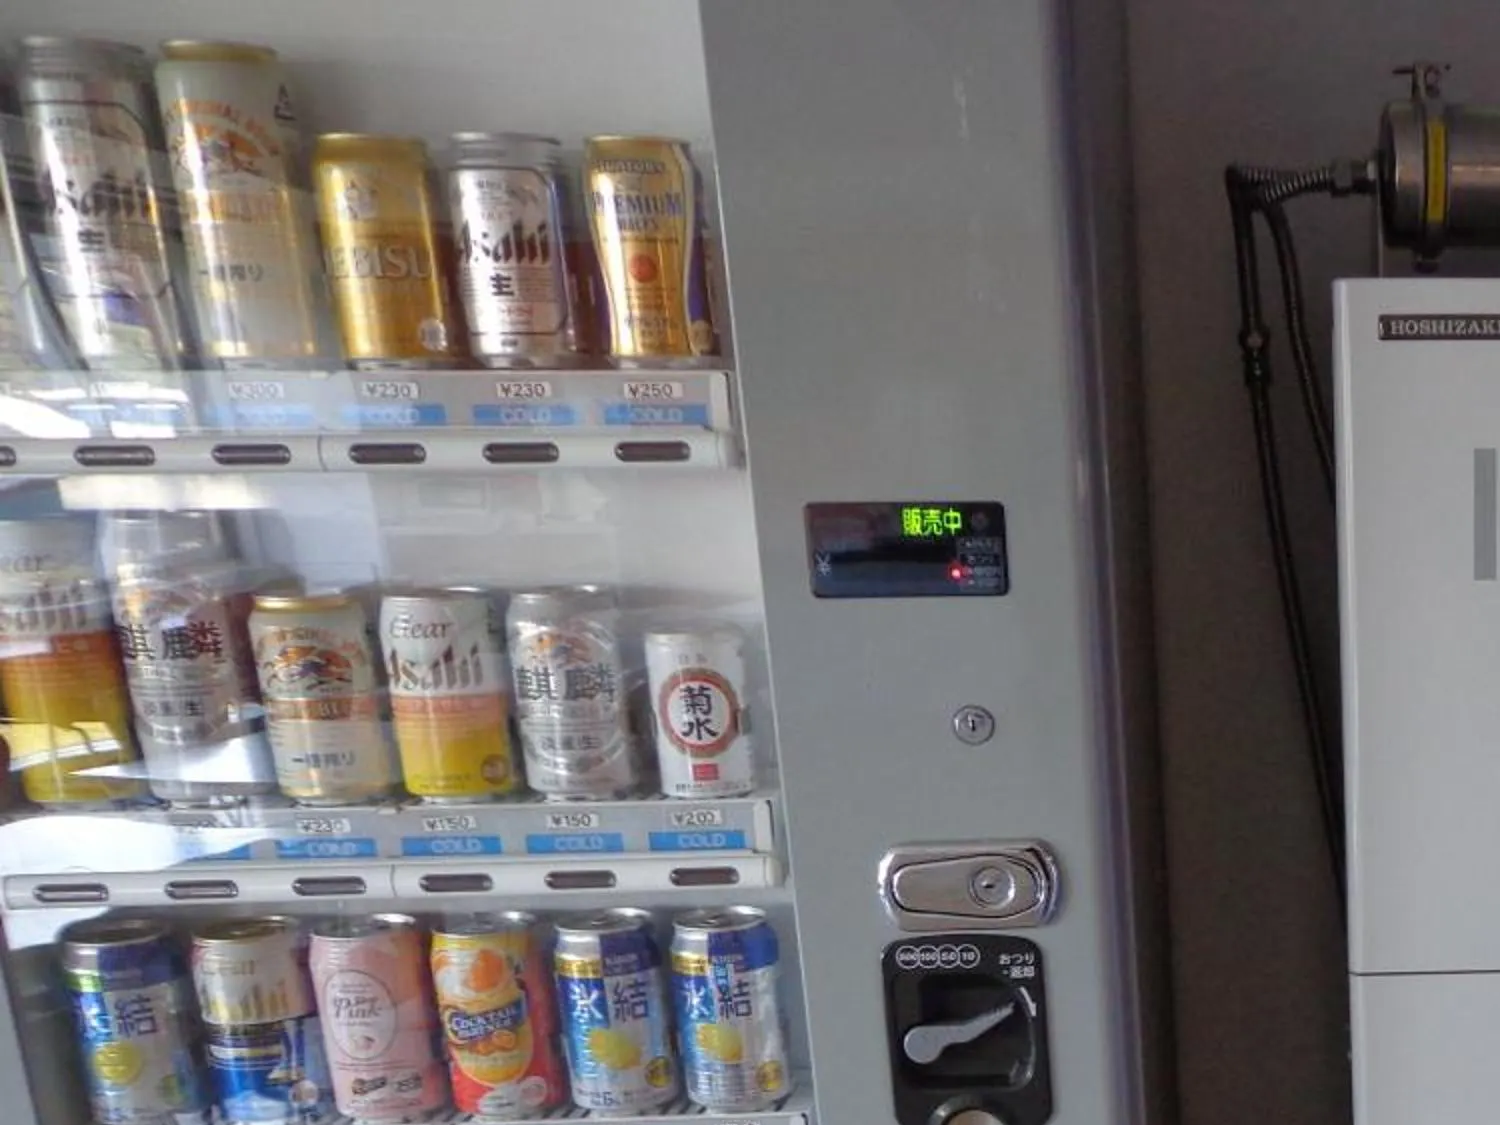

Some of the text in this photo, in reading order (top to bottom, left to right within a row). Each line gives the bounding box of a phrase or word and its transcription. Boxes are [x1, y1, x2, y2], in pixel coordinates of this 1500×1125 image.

[500, 383, 546, 398] ¥230
[627, 383, 674, 398] ¥250
[902, 507, 963, 536] 販売中
[678, 685, 720, 741] 菊水
[552, 814, 591, 828] ¥150
[431, 838, 482, 854] COLD
[554, 835, 604, 850] COLD
[677, 832, 725, 847] COLD
[569, 980, 649, 1026] 氷結
